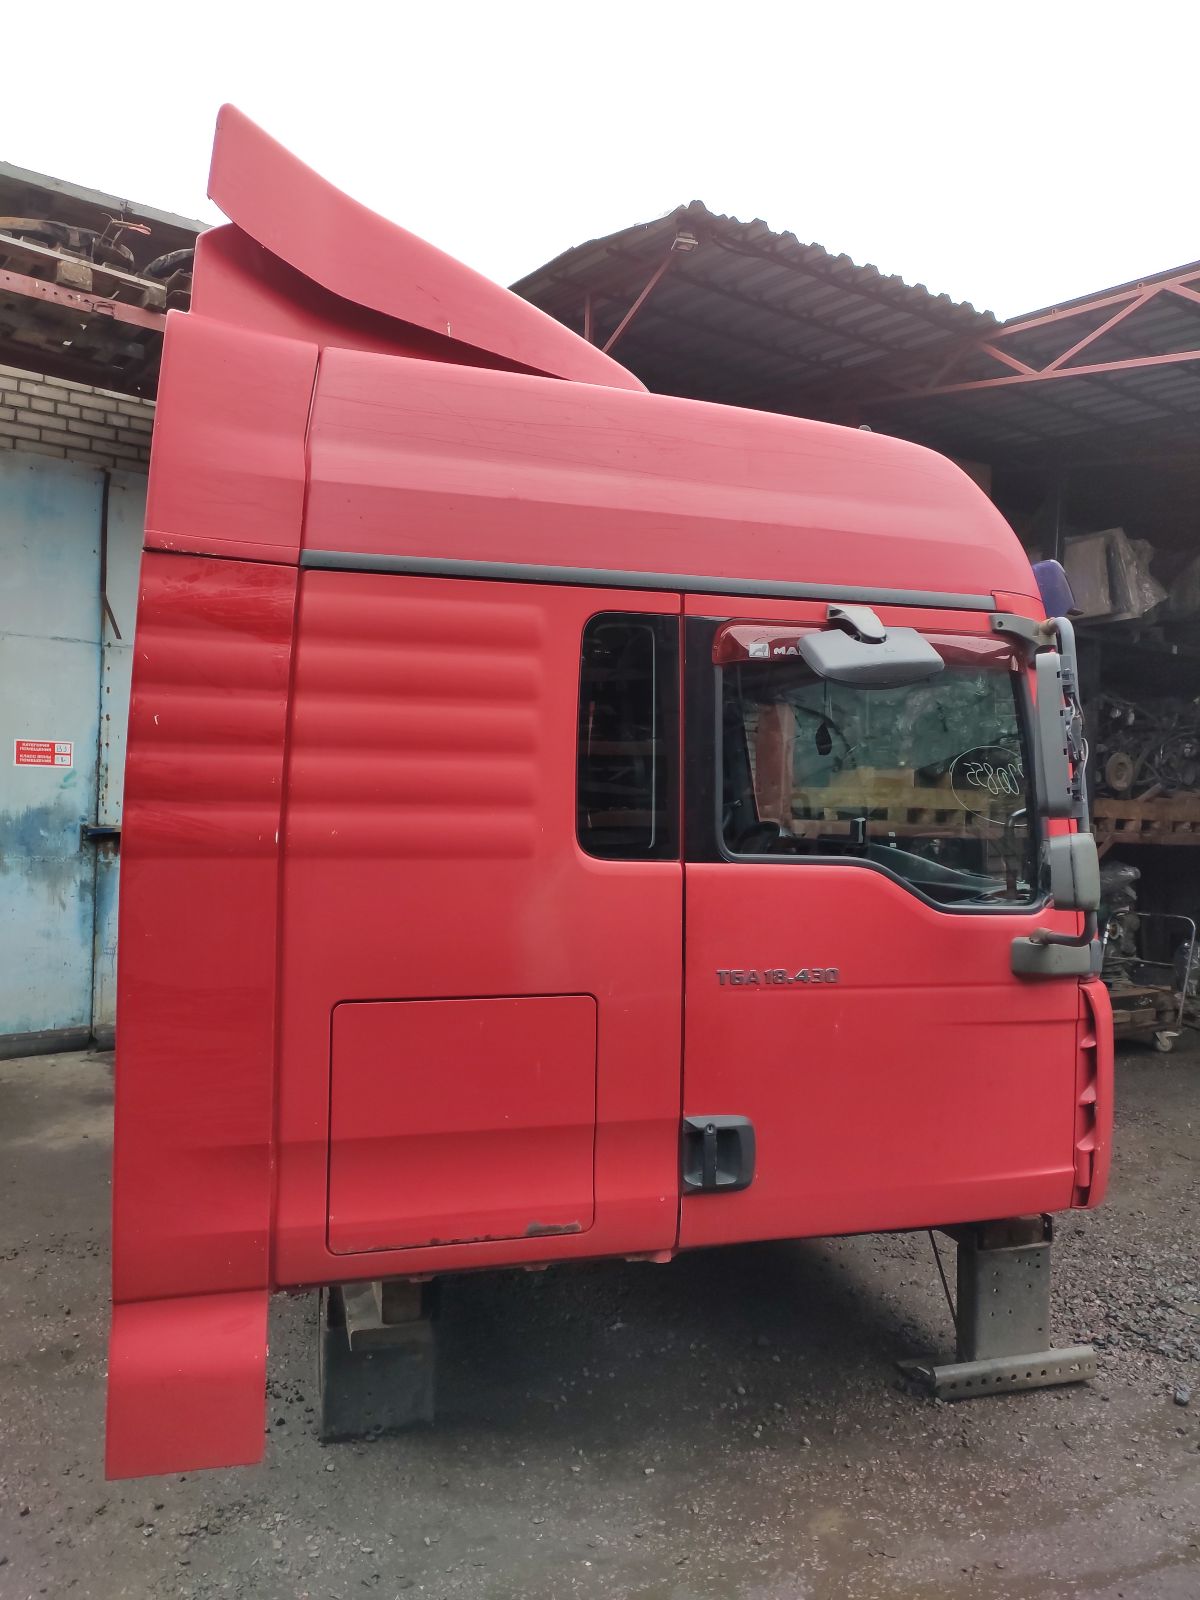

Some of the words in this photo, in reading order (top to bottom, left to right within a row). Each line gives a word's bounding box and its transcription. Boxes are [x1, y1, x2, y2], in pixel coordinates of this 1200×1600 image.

[773, 646, 802, 656] MA
[716, 968, 761, 986] TGA
[764, 967, 839, 985] 18.430
